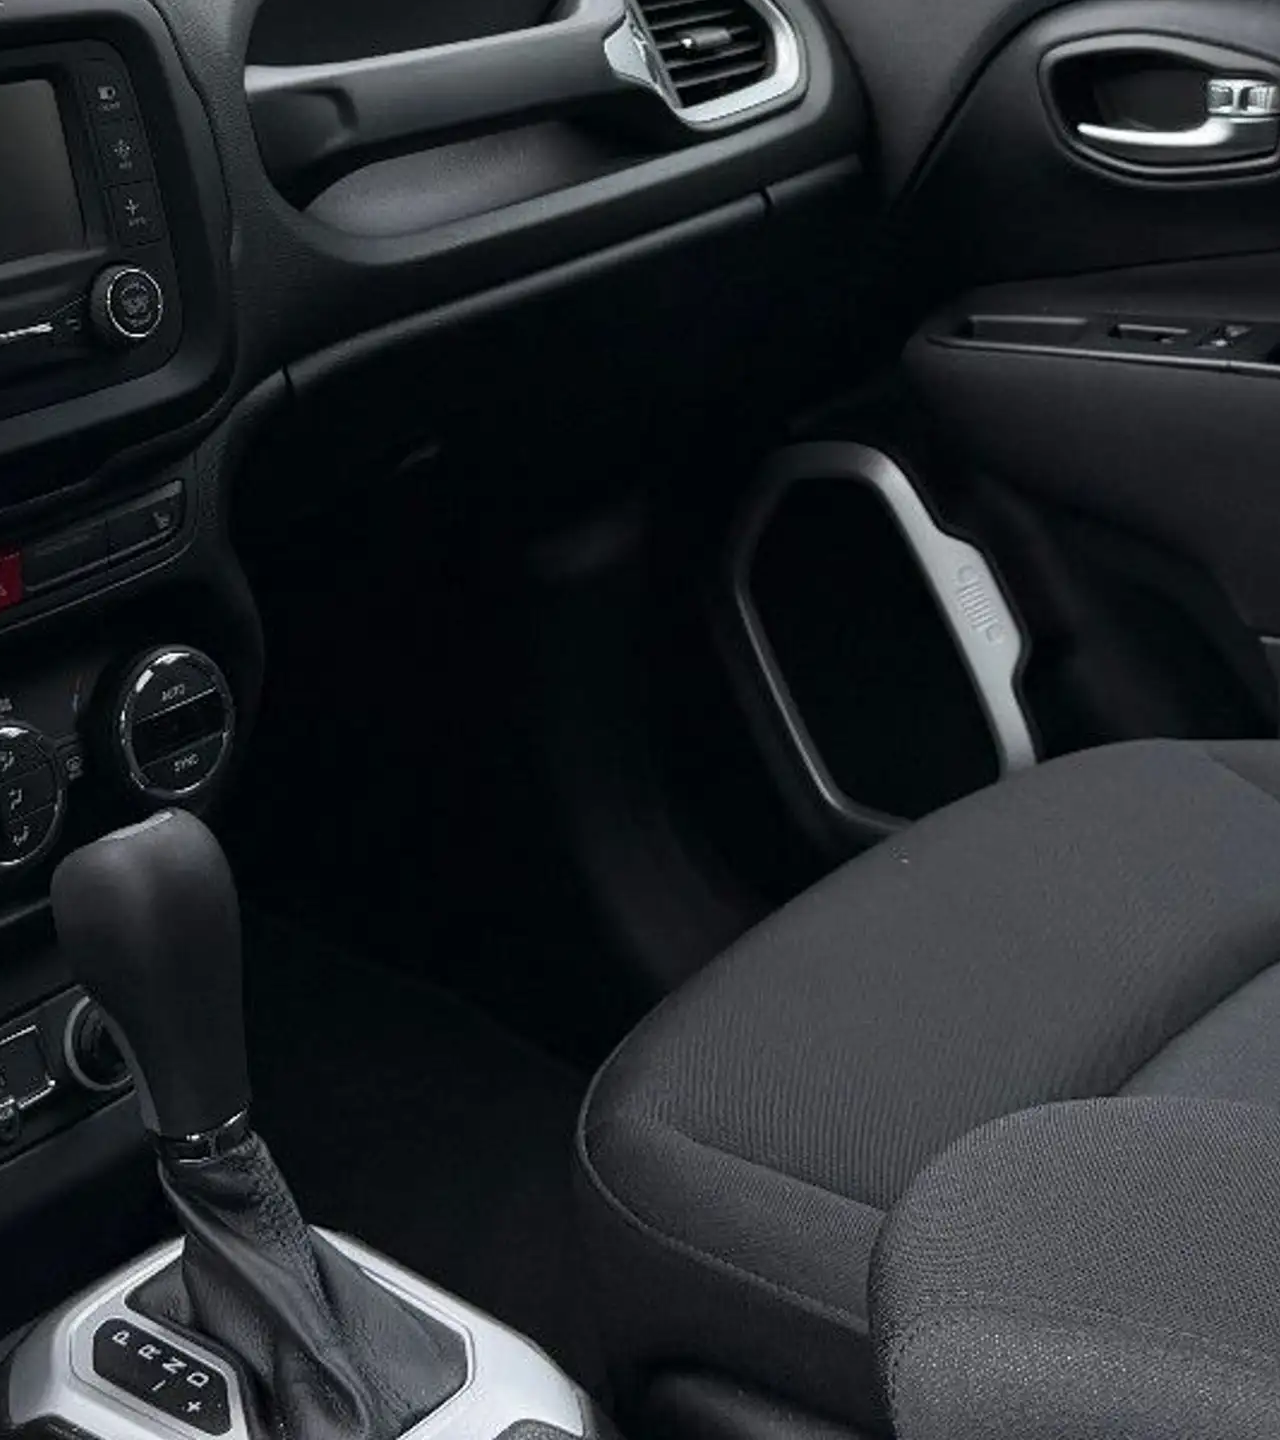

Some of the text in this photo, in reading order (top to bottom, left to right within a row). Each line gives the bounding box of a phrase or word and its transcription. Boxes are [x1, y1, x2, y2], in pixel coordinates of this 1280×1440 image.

[111, 1329, 211, 1389] P R N D
